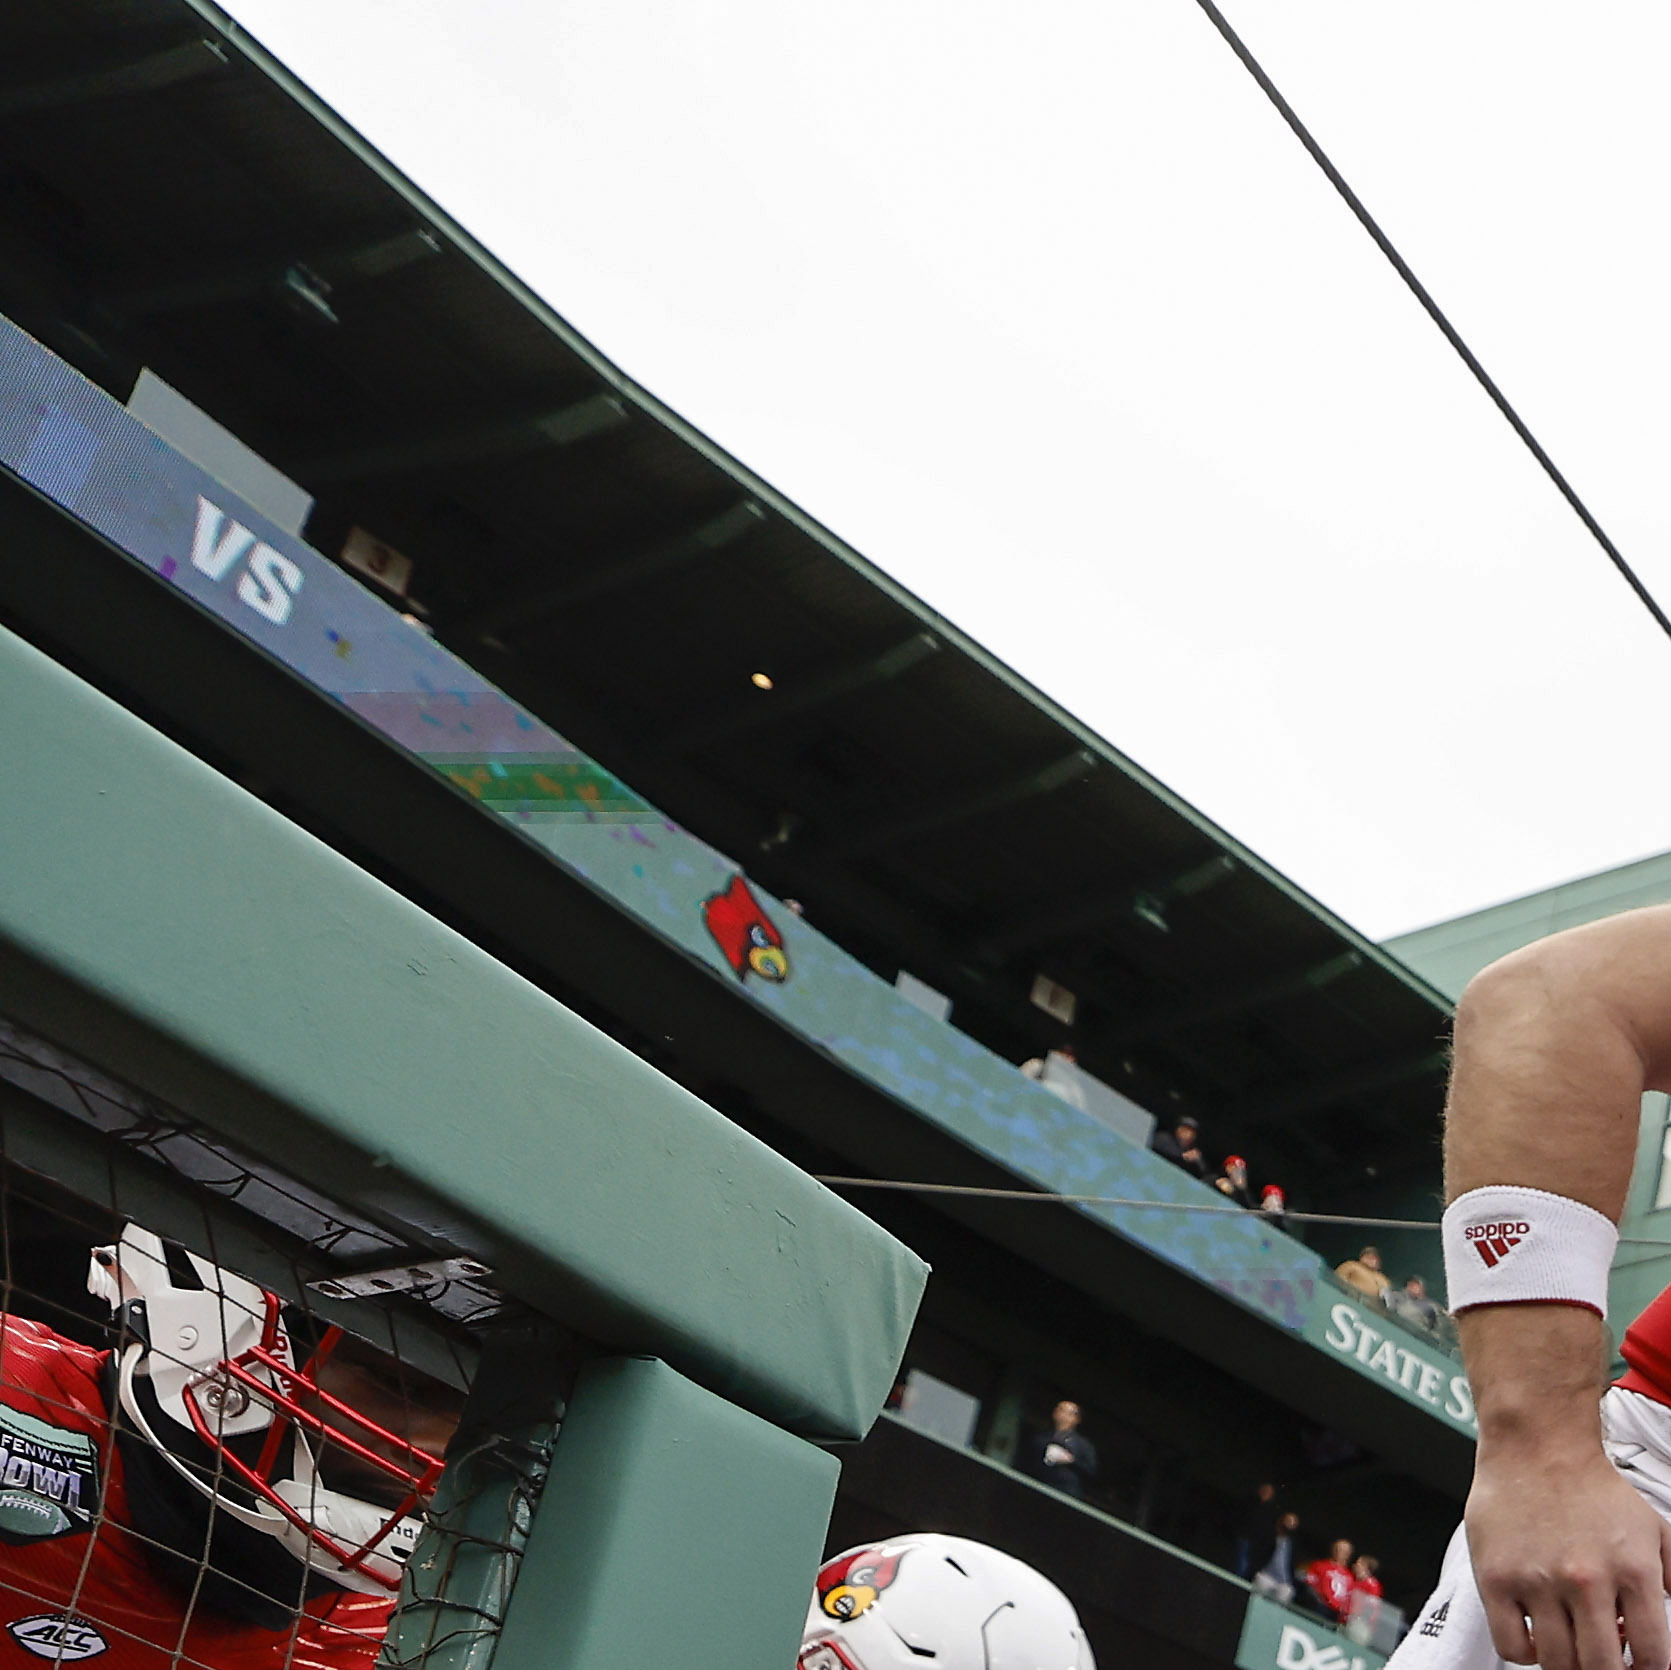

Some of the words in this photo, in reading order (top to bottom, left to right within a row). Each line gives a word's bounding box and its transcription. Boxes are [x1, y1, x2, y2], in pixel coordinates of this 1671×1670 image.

[190, 494, 303, 625] VS
[1465, 1222, 1530, 1241] adidas
[1325, 1303, 1443, 1406] STATE
[1, 1433, 73, 1469] FENWAY
[0, 1447, 90, 1523] OWL
[25, 1624, 101, 1651] ACC
